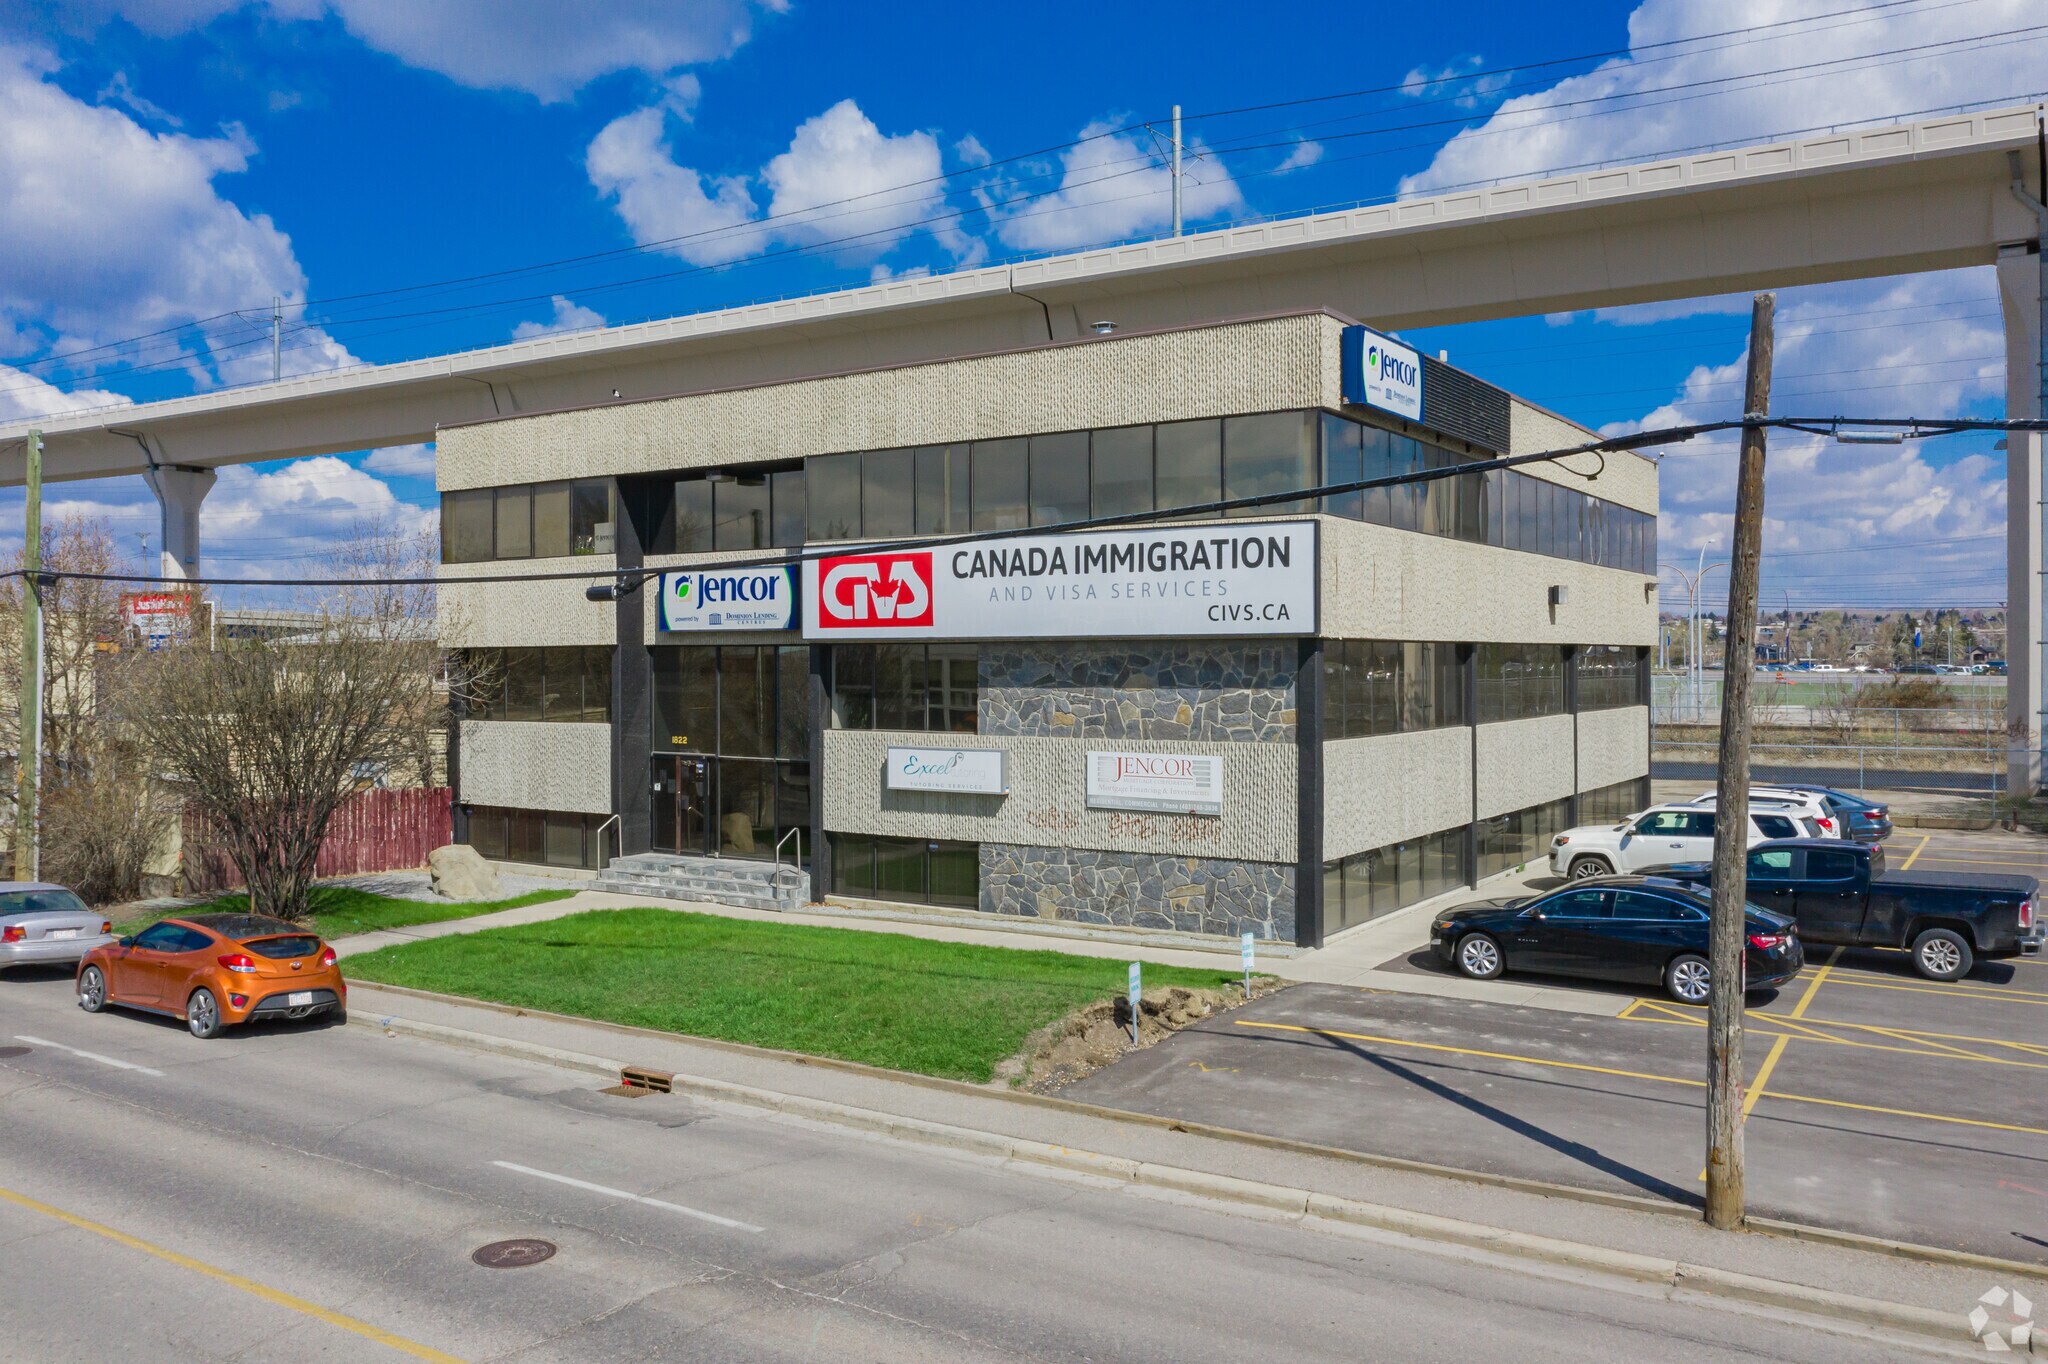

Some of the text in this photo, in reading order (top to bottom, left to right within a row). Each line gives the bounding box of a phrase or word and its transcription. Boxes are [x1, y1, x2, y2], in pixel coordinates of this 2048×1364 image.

[1380, 348, 1416, 387] Jencor
[952, 536, 1291, 579] CANADA IMMIGRATION
[696, 574, 780, 610] Jencor
[989, 579, 1228, 602] AND VISA SERVICES
[1208, 603, 1291, 622] CIVS.CA
[672, 736, 688, 744] 1822
[903, 755, 955, 778] Excel
[1112, 757, 1194, 783] JENCOR
[1098, 783, 1128, 793] Mortgage
[1129, 786, 1160, 795] Financing
[1170, 788, 1210, 797] Investments
